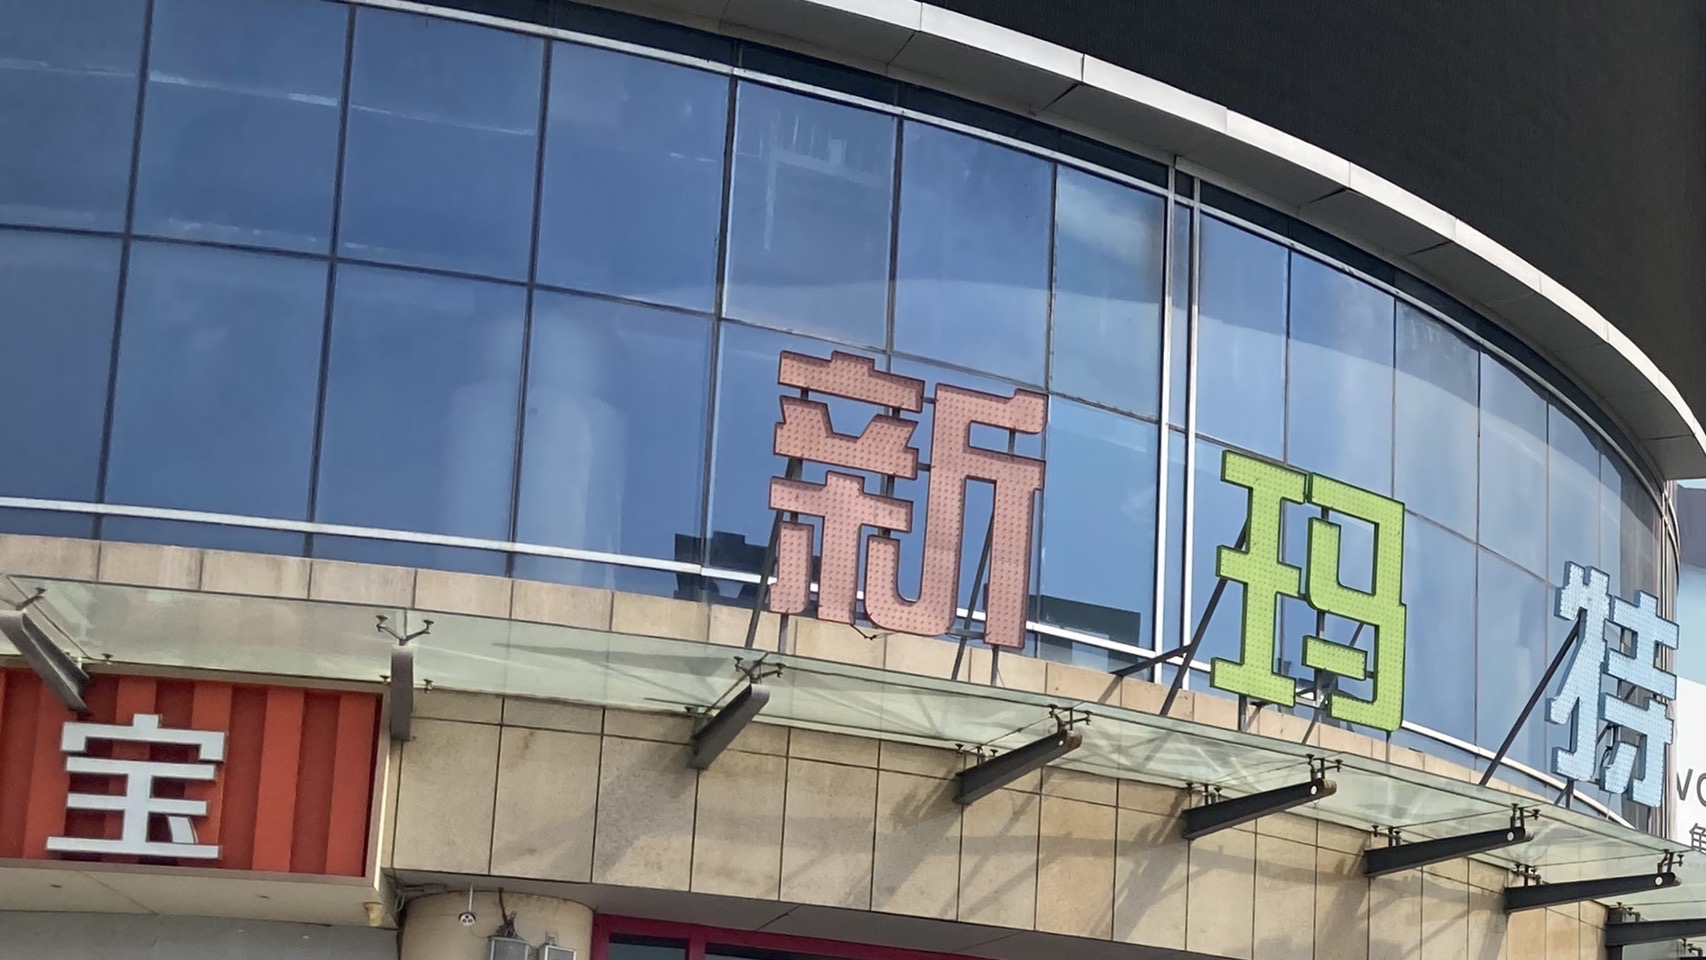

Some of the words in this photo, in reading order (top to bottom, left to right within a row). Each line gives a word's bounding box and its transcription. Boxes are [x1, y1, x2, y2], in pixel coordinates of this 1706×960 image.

[769, 349, 1679, 808] 新玛特
[46, 713, 227, 859] 宝
